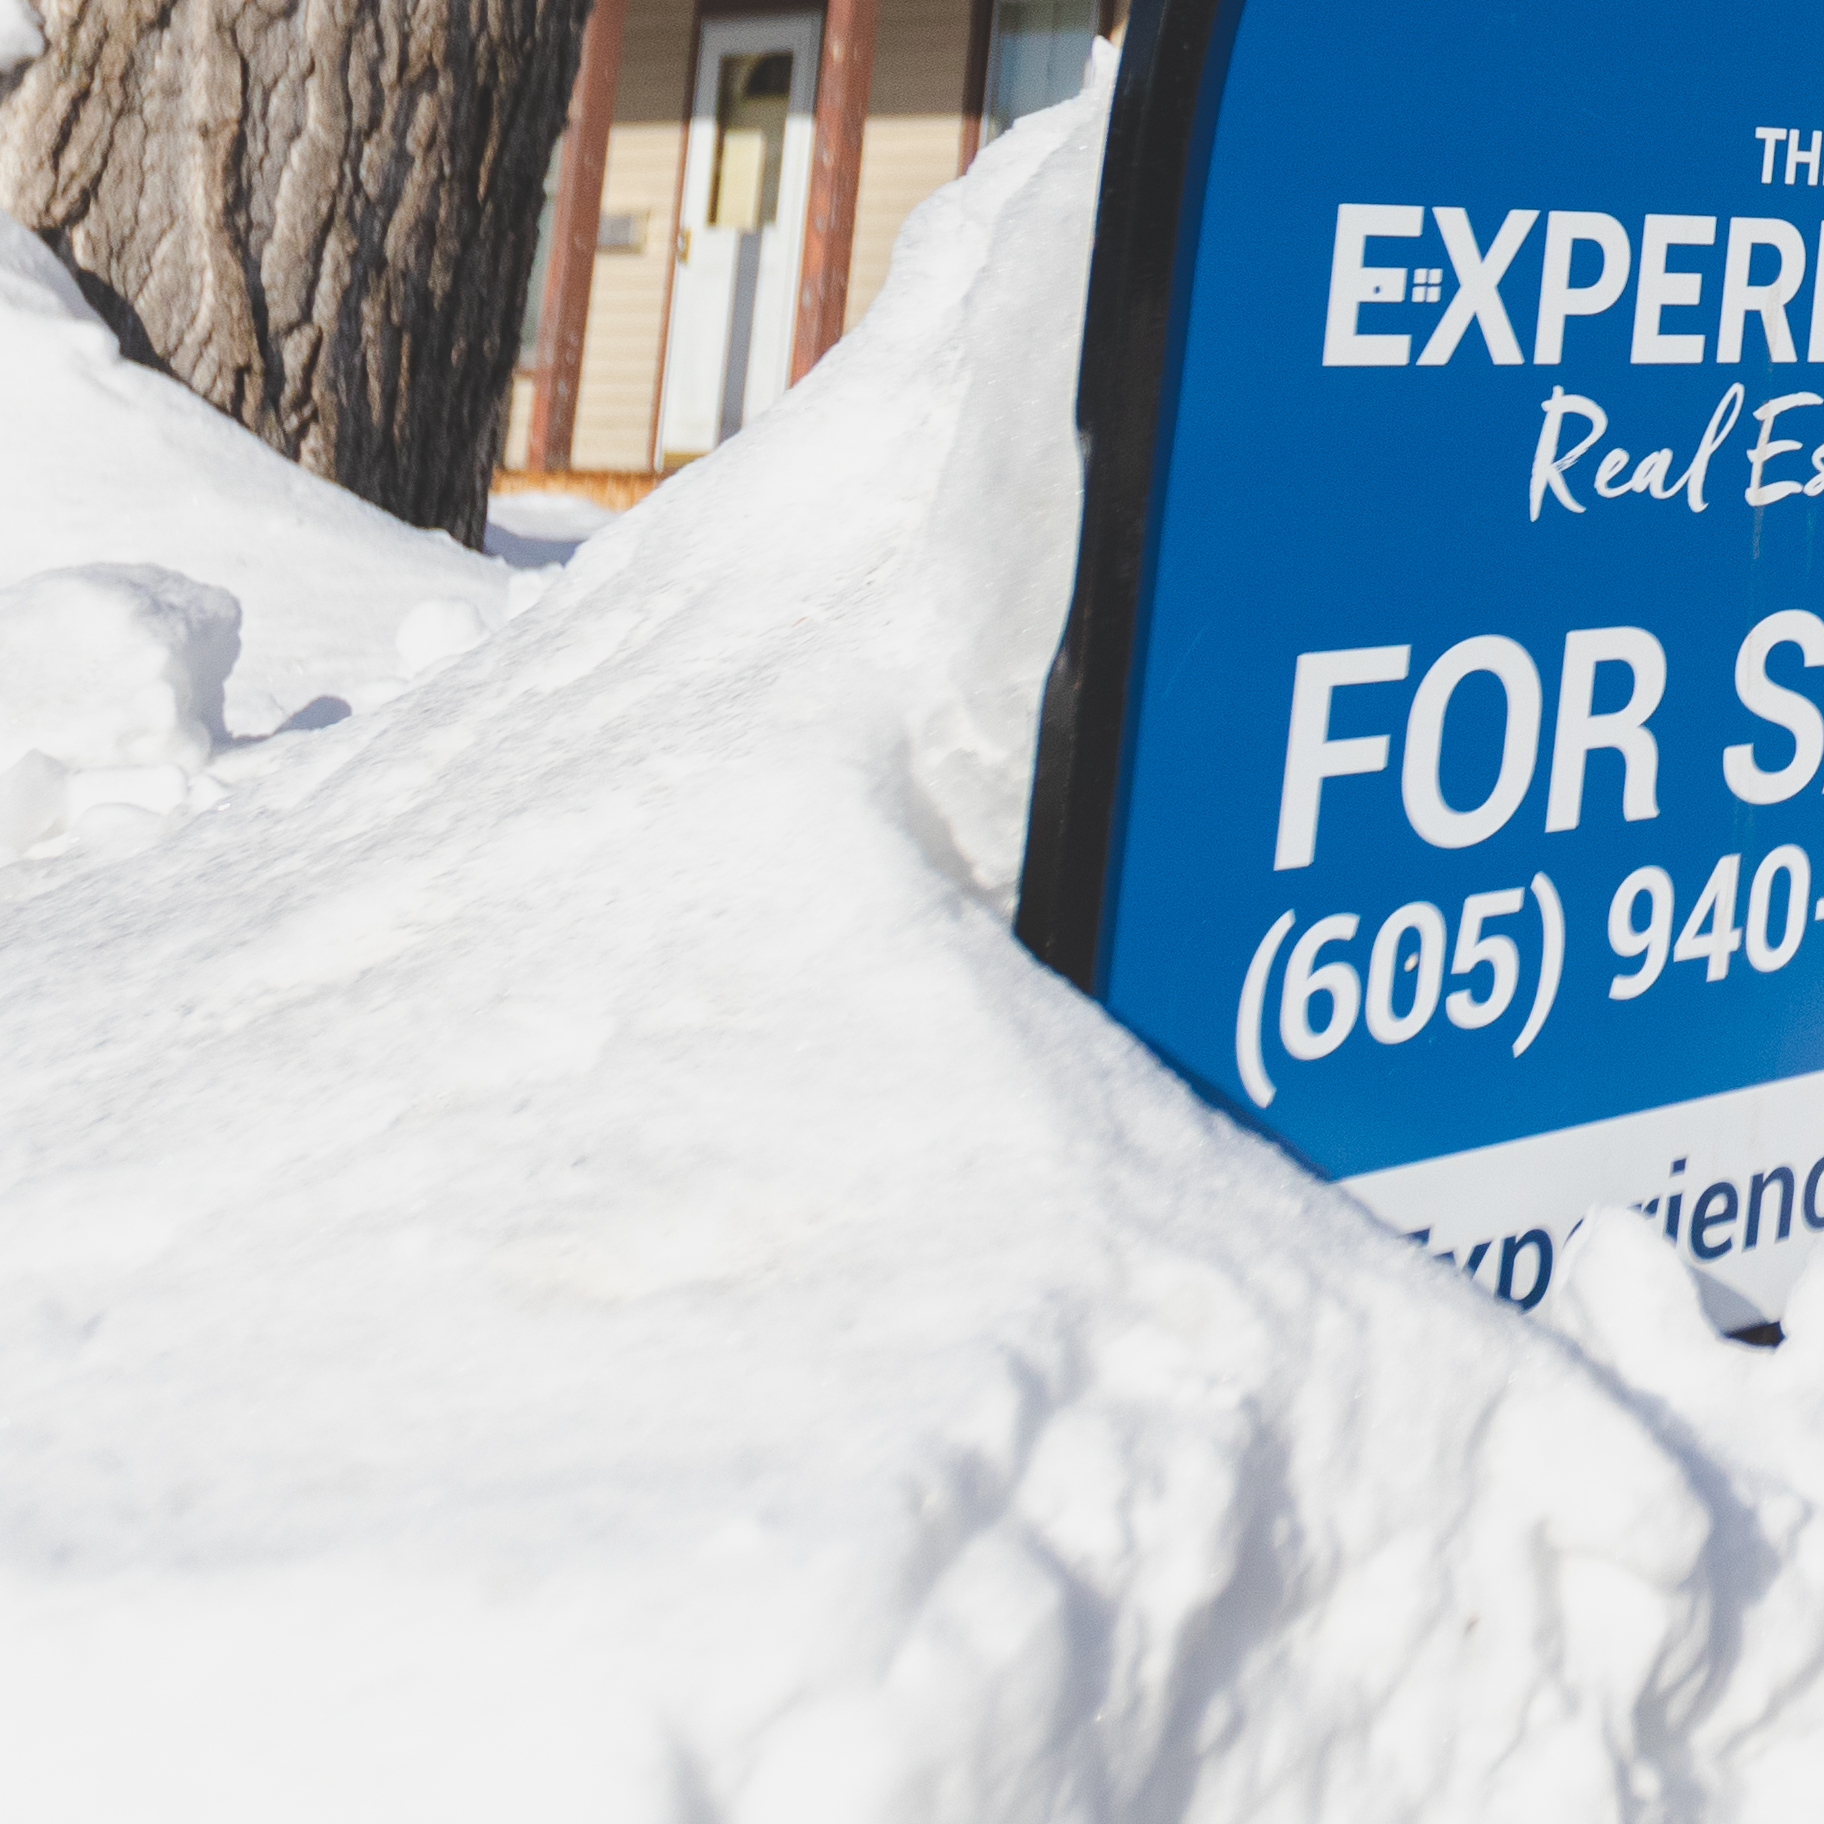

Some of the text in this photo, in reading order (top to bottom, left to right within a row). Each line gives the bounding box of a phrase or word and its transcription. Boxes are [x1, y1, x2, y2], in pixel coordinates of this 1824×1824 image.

[1529, 381, 1745, 523] Real
[1273, 625, 1667, 872] FOR
[1235, 871, 1566, 1109] (605)
